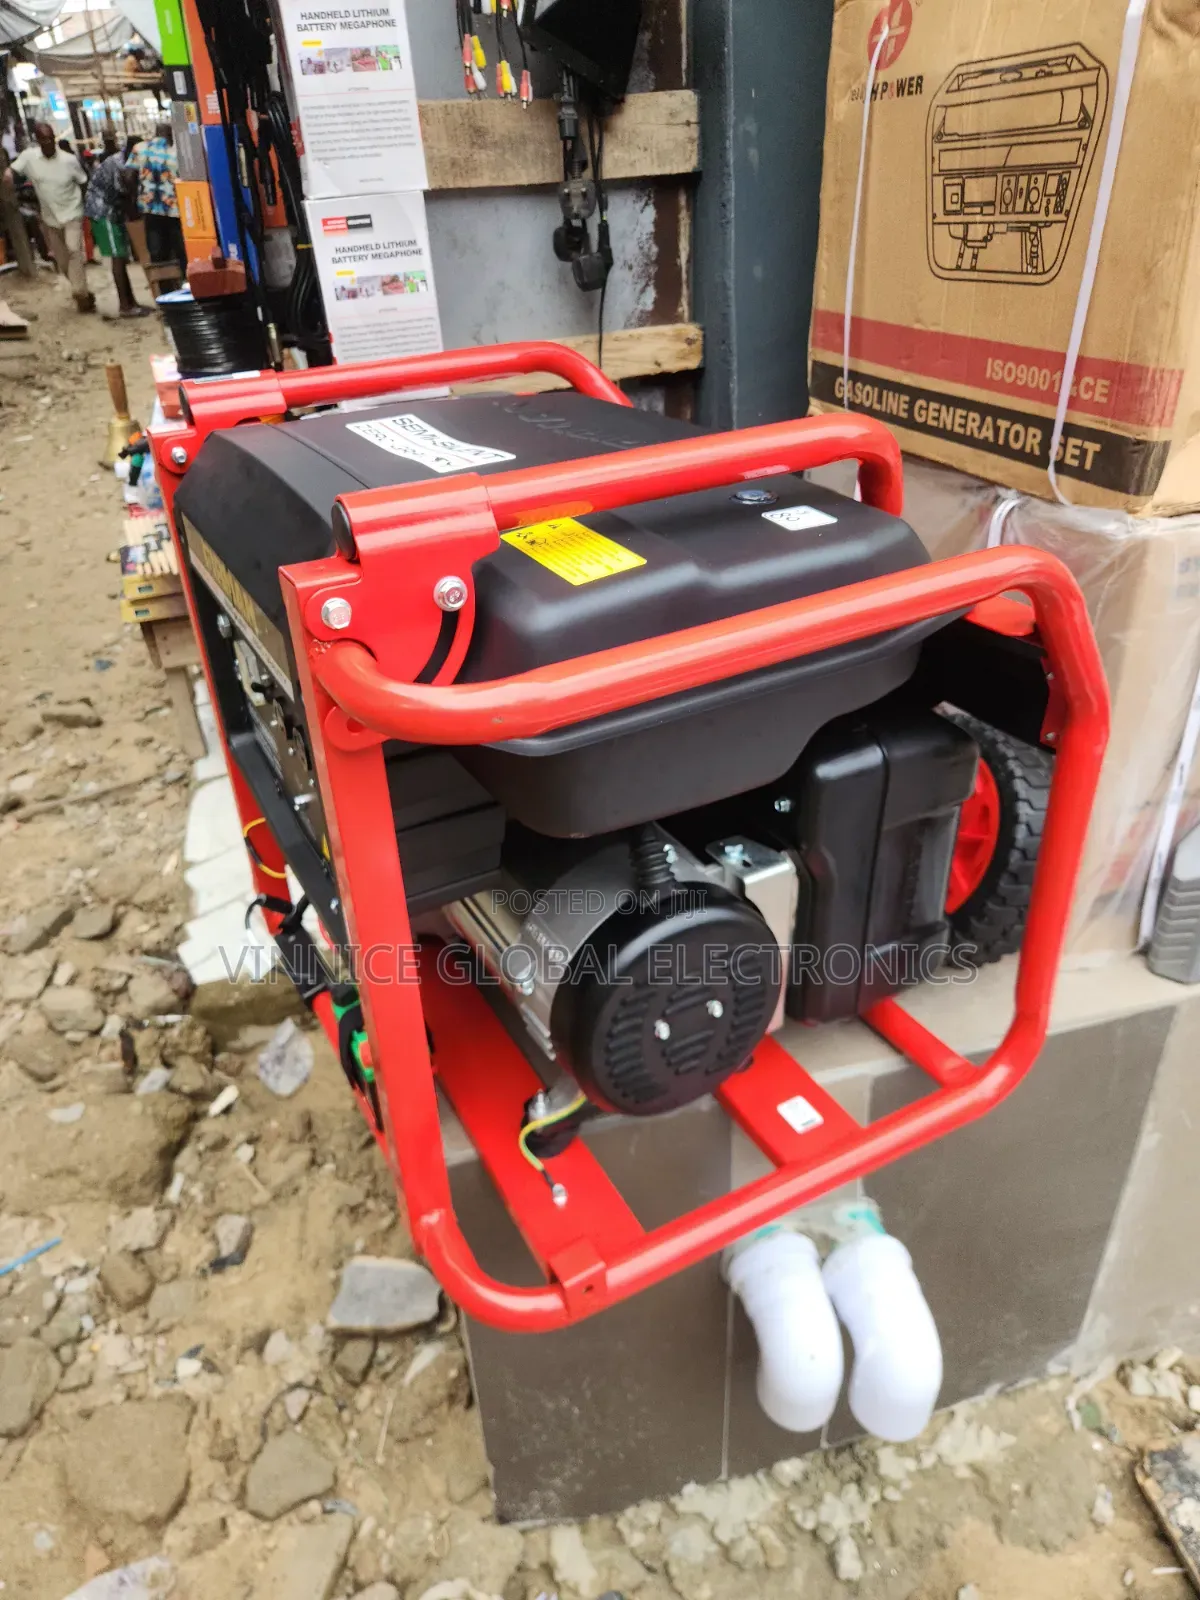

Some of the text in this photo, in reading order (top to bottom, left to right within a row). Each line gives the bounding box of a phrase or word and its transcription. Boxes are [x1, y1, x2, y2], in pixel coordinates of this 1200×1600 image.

[300, 8, 390, 21] HANDHELD LITHIUM
[297, 19, 397, 32] BATTERY MEGAPHONE
[335, 239, 417, 254] HANDHELD LITHIUM
[331, 249, 423, 264] BATTERY MEGAPHONE
[834, 376, 910, 419] GASOLINE
[913, 398, 1043, 456] GENERATOR
